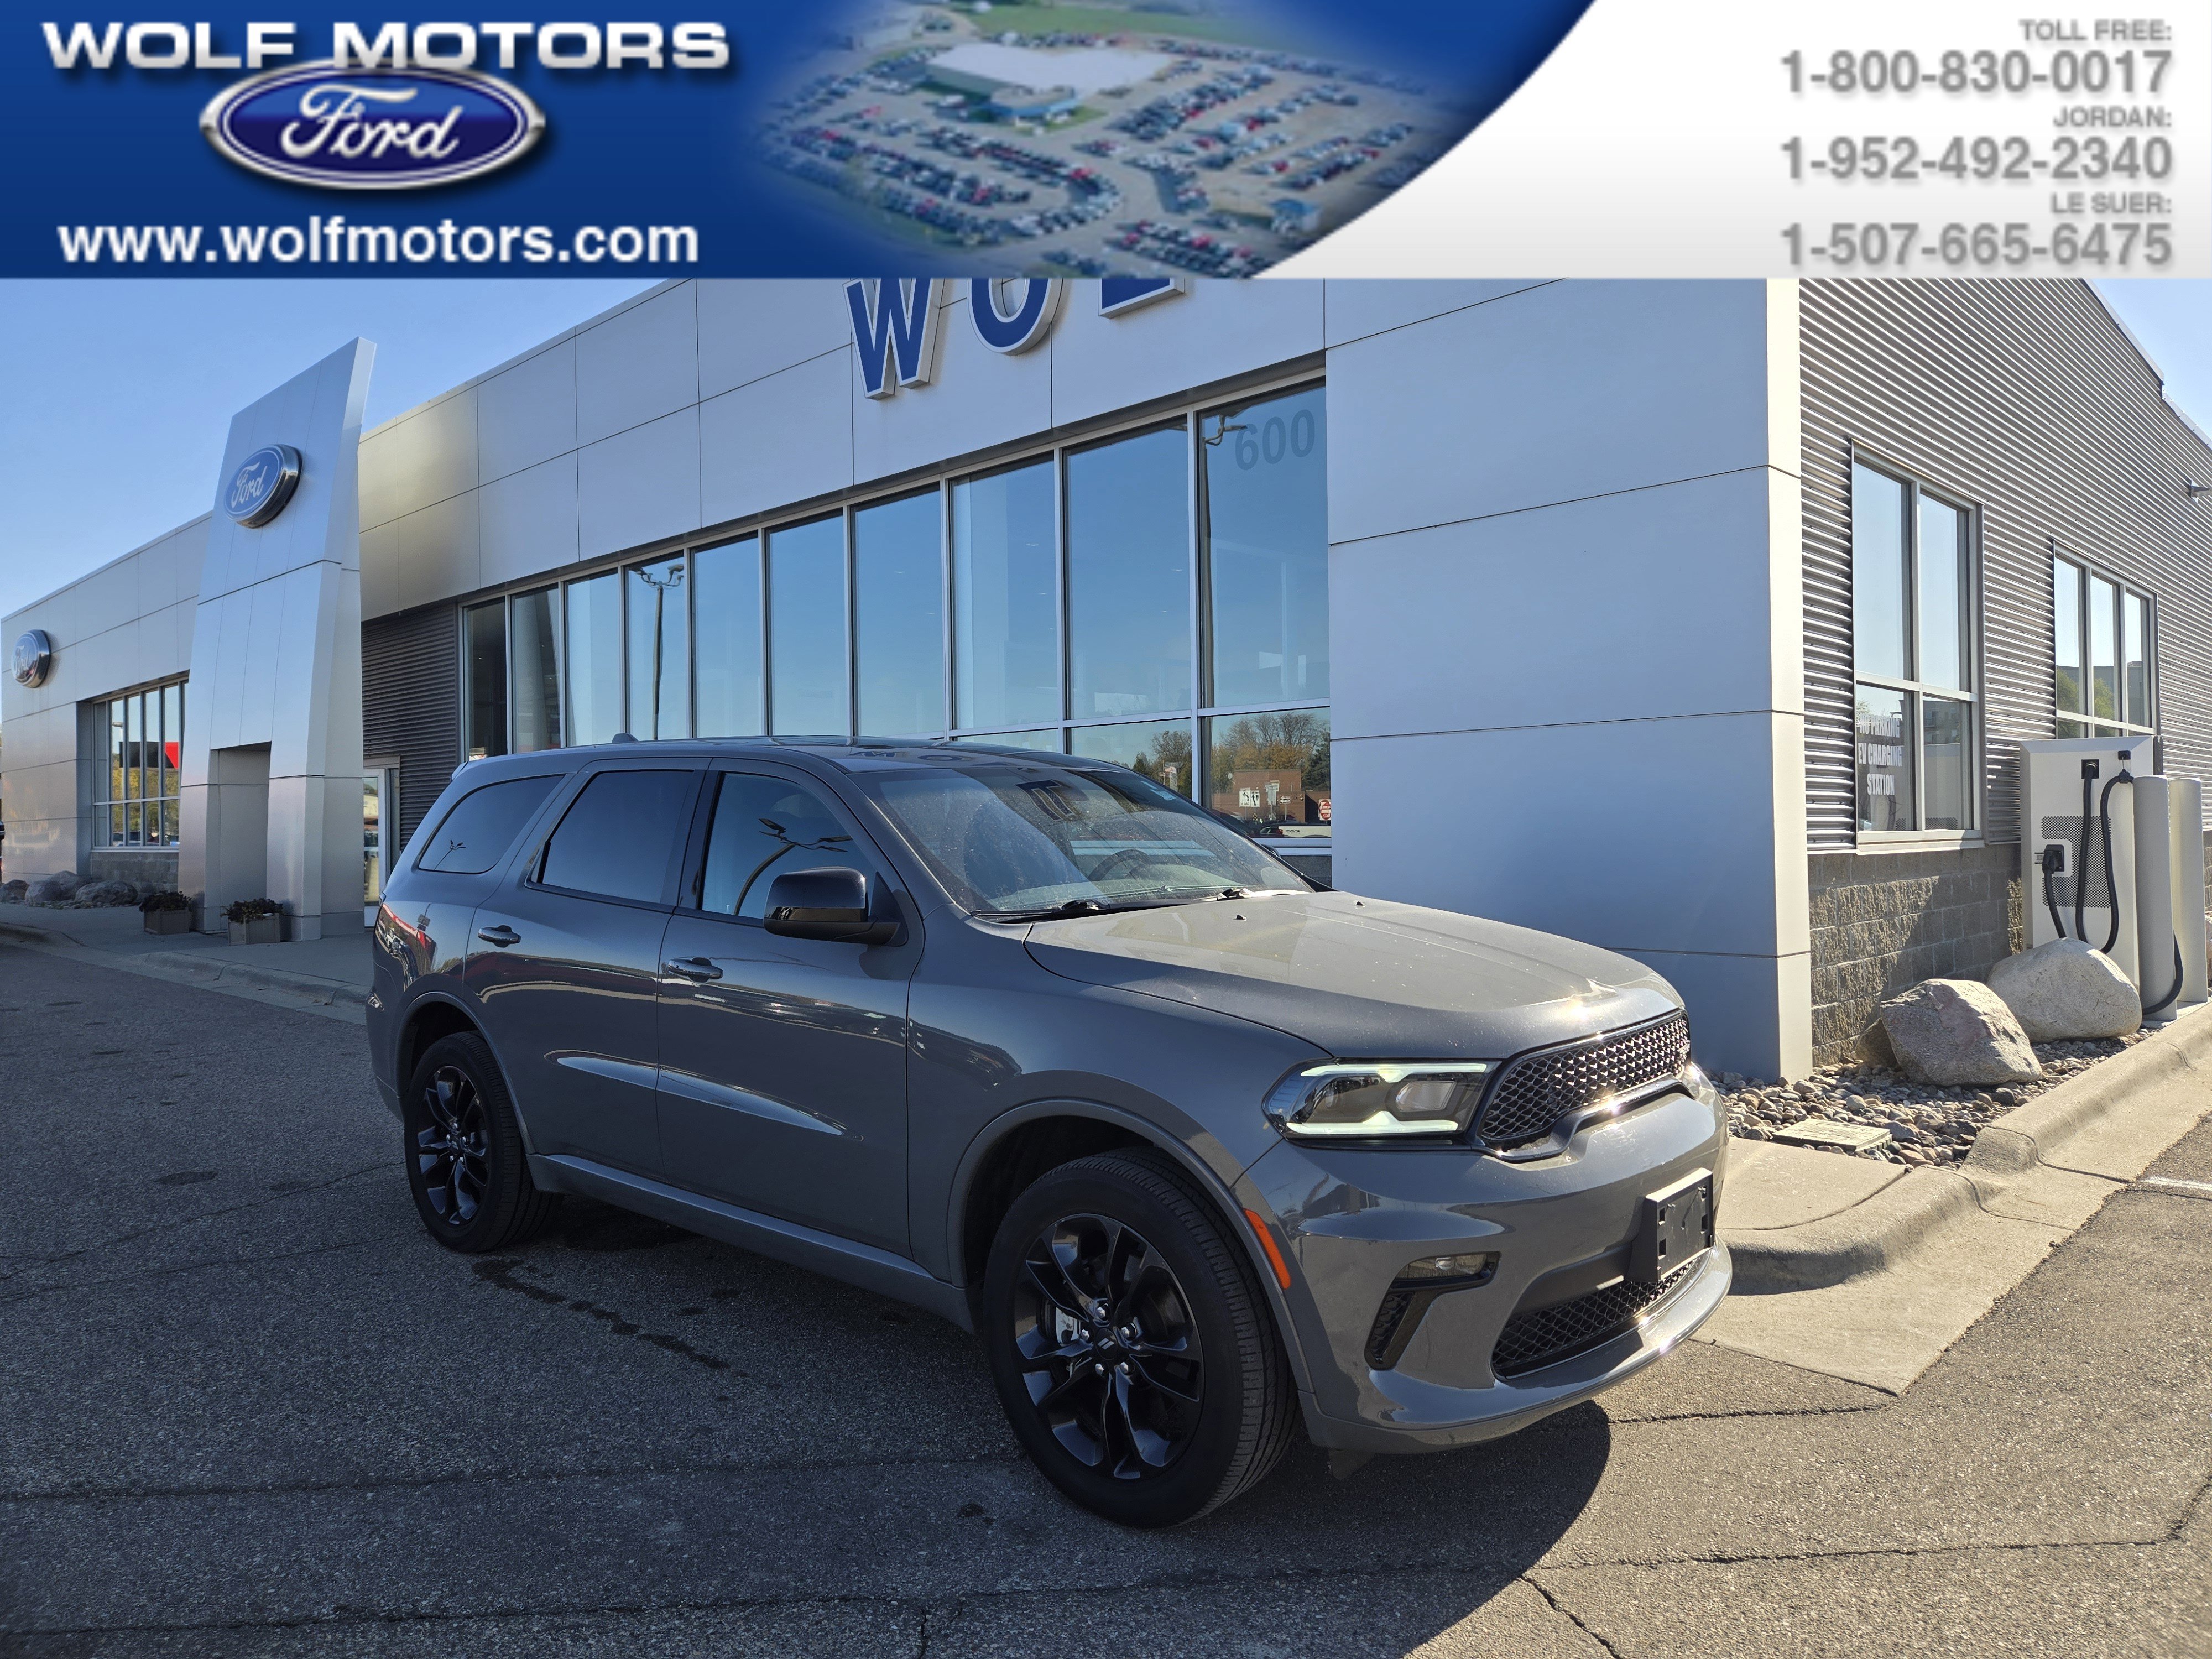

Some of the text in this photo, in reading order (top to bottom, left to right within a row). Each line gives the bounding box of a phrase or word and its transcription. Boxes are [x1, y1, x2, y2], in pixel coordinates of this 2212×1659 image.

[843, 278, 1185, 399] WO
[1235, 409, 1315, 470] 600
[231, 461, 268, 508] Ford
[15, 644, 30, 676] Ford
[1859, 713, 1900, 738] NO PARKING
[1858, 742, 1902, 767] EV CHARGING
[1867, 773, 1895, 796] STATION
